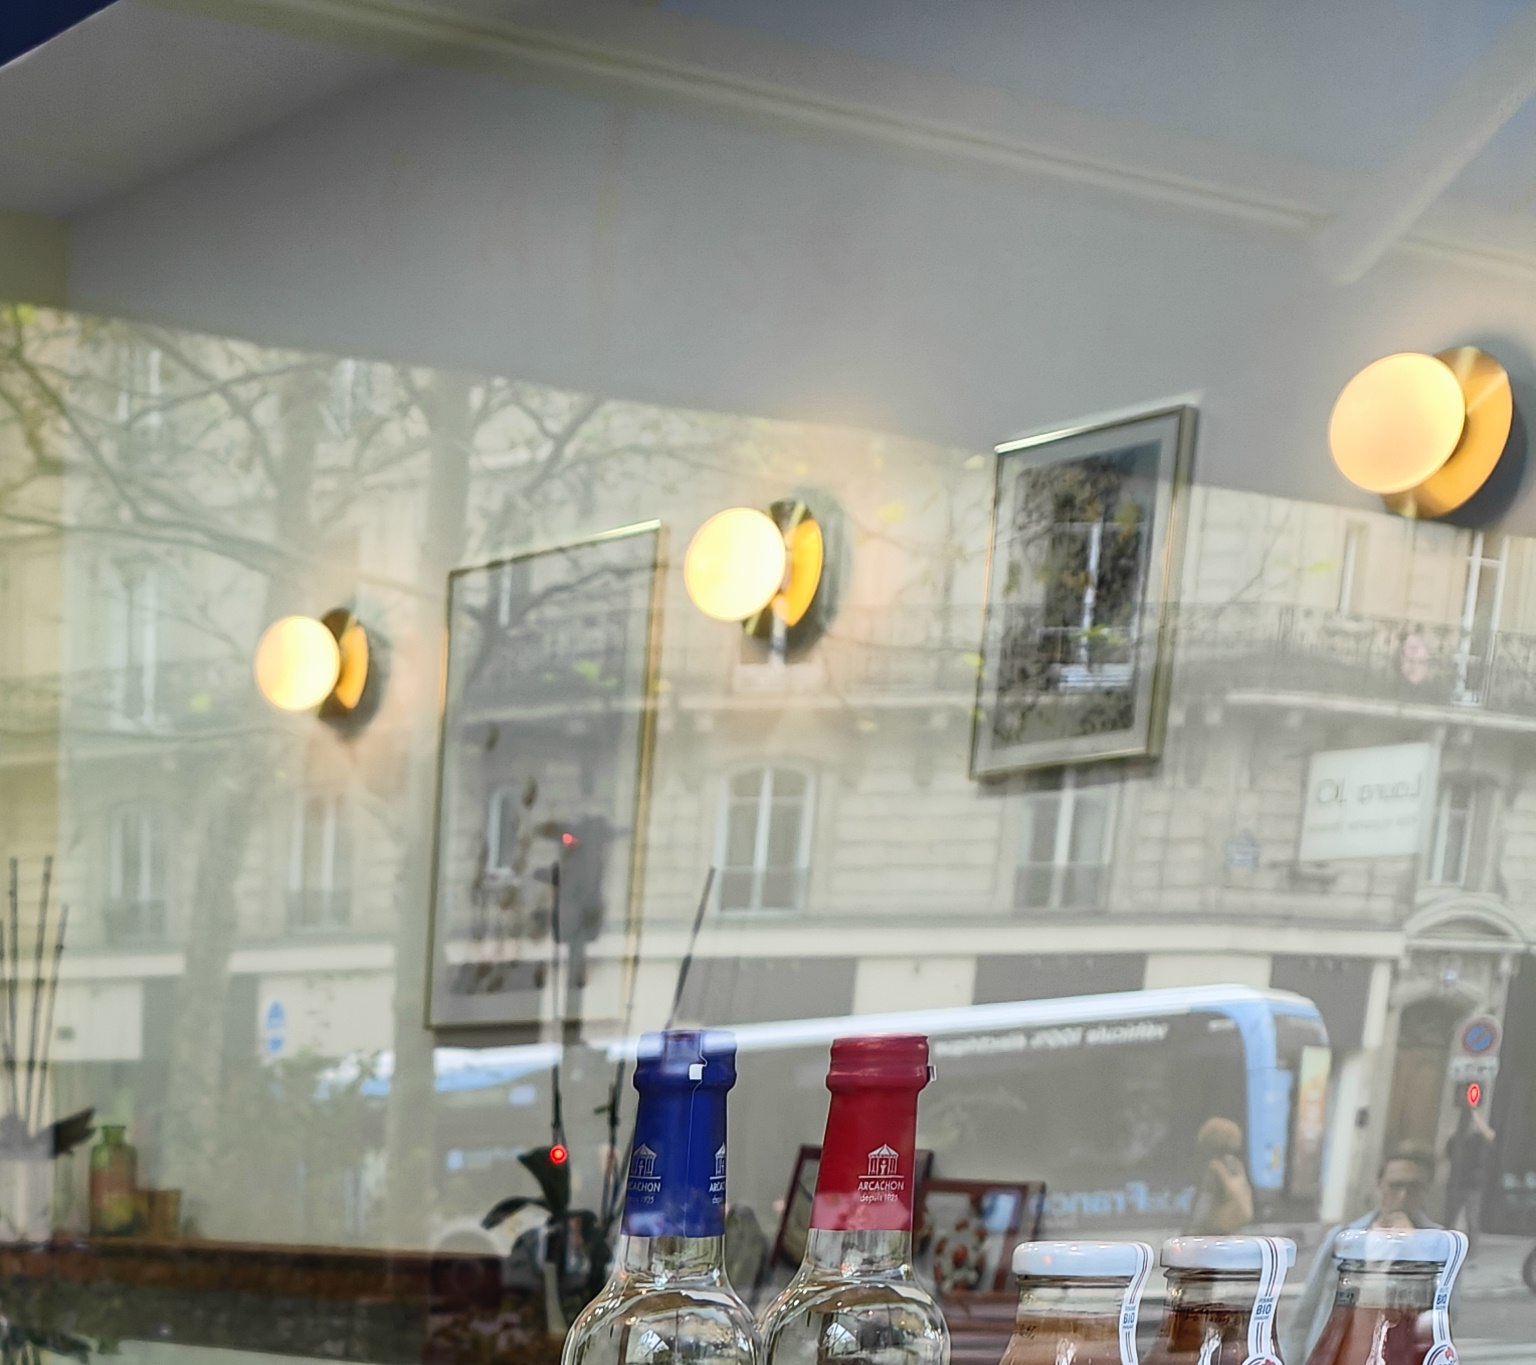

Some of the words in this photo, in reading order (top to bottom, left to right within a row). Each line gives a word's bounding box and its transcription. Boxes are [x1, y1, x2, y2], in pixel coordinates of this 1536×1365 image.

[857, 1180, 904, 1191] ARCACHON
[1256, 1303, 1272, 1315] BIO
[1123, 1312, 1135, 1324] BIO
